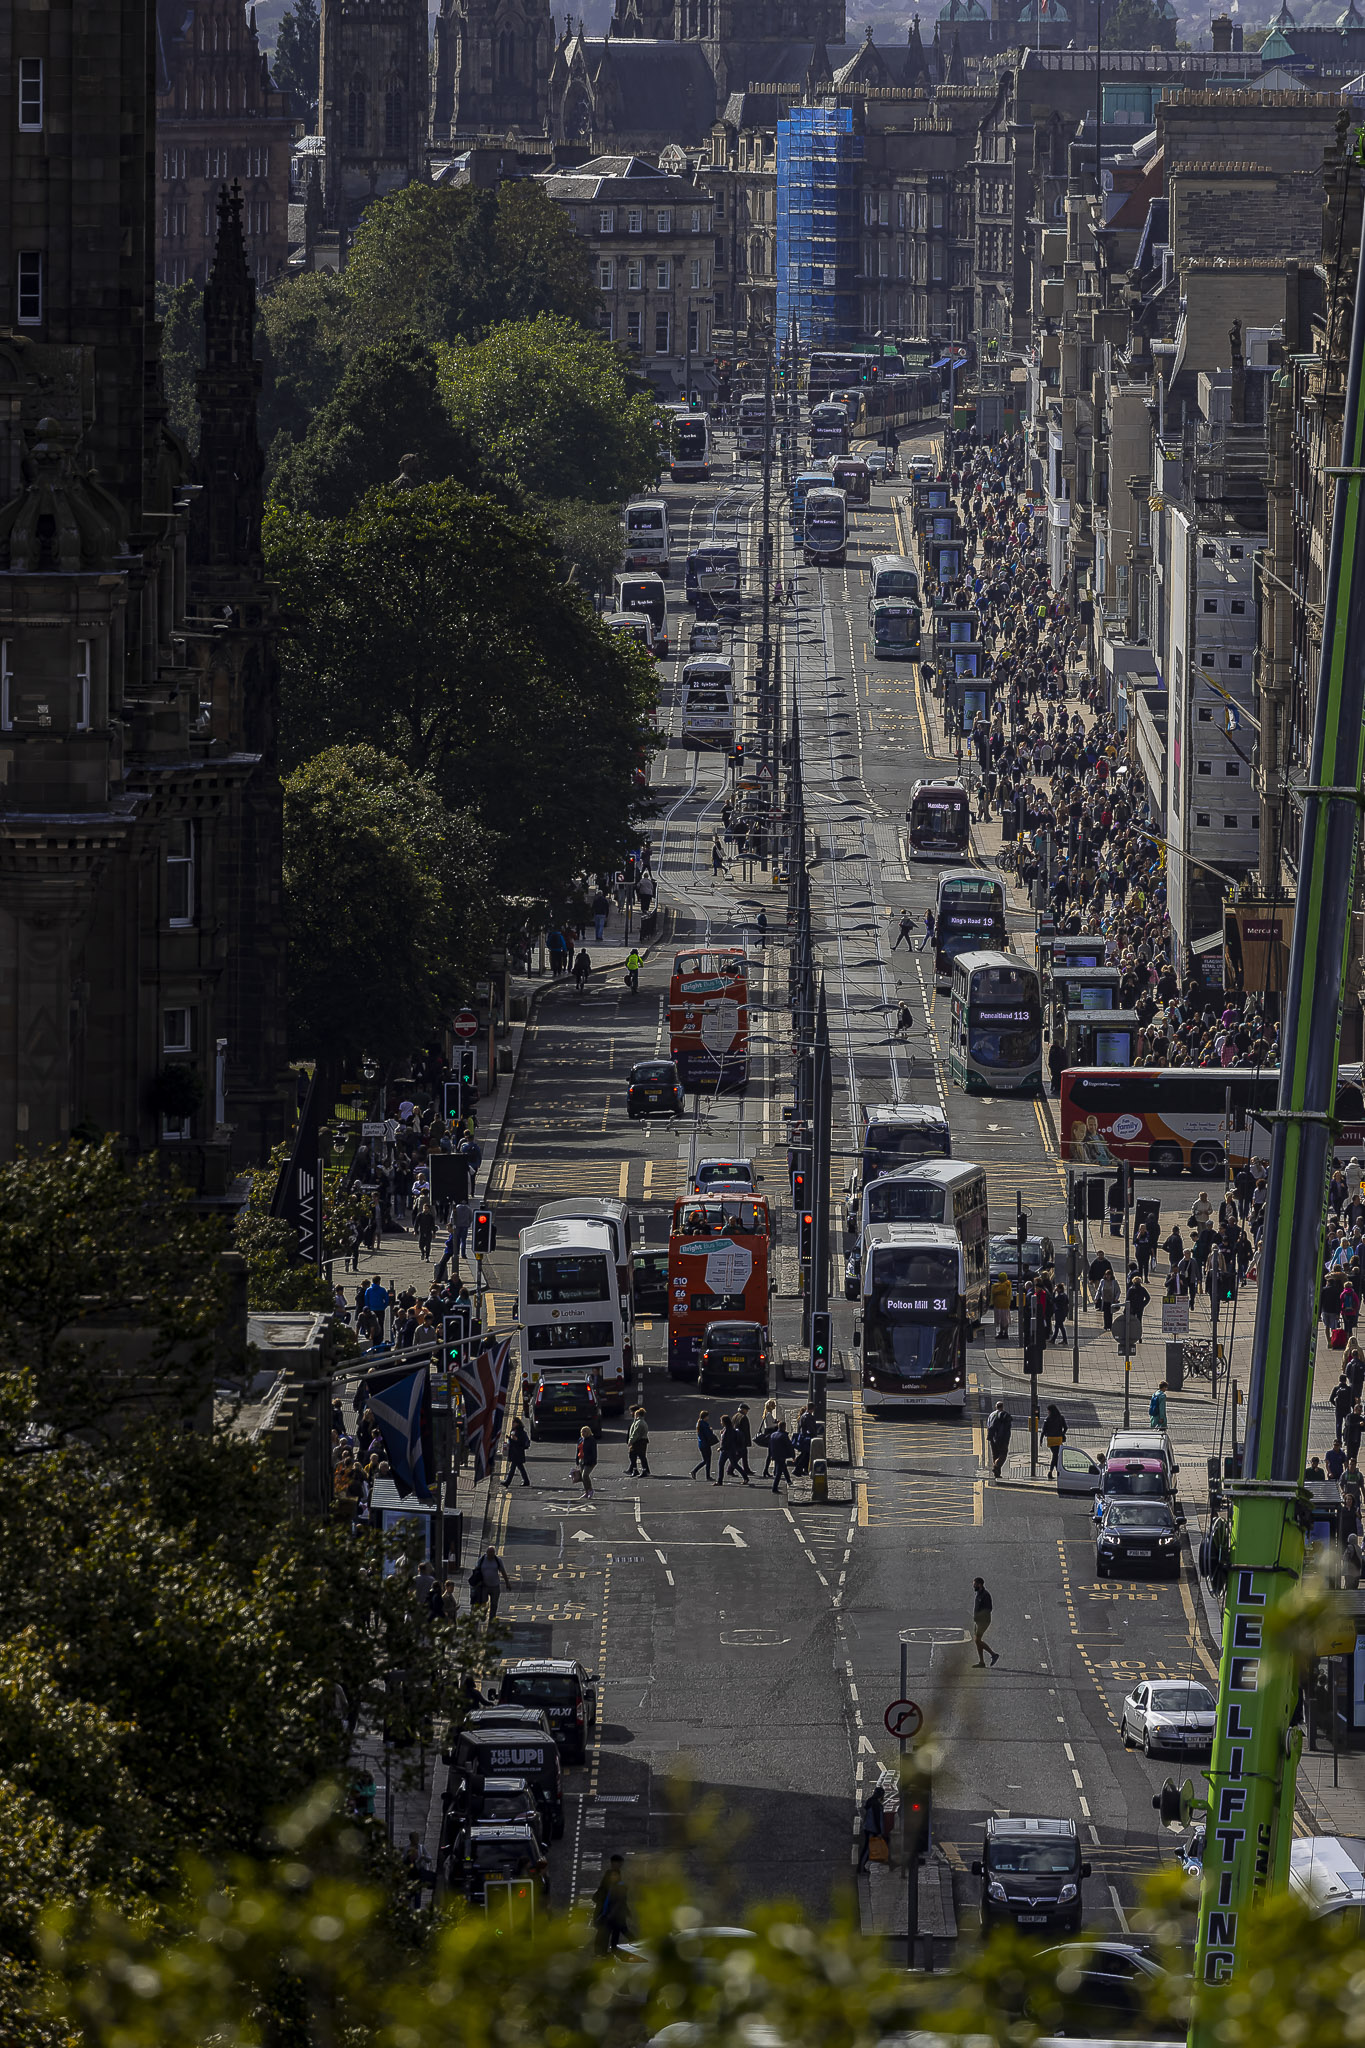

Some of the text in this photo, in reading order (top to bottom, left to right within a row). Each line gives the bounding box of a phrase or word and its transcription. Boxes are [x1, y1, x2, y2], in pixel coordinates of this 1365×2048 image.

[953, 803, 961, 811] 30
[982, 917, 993, 927] 19
[683, 982, 702, 991] Bright
[1013, 1011, 1030, 1020] 113
[1117, 1122, 1139, 1132] family
[682, 1244, 703, 1253] Bright
[673, 1277, 688, 1285] £10
[537, 1290, 552, 1301] X15
[675, 1290, 686, 1298] £6
[673, 1304, 688, 1312] £29
[887, 1298, 948, 1311] Polton Mill 31
[561, 1309, 585, 1317] Lothian
[1077, 1583, 1170, 1592] STOP
[1088, 1592, 1159, 1601] BUS
[1228, 1570, 1267, 1693] LEE
[1094, 1660, 1206, 1671] STOP
[549, 1707, 572, 1716] TAXI
[490, 1749, 511, 1757] THE
[490, 1757, 511, 1765] POP
[1204, 1704, 1253, 1988] LIFTING
